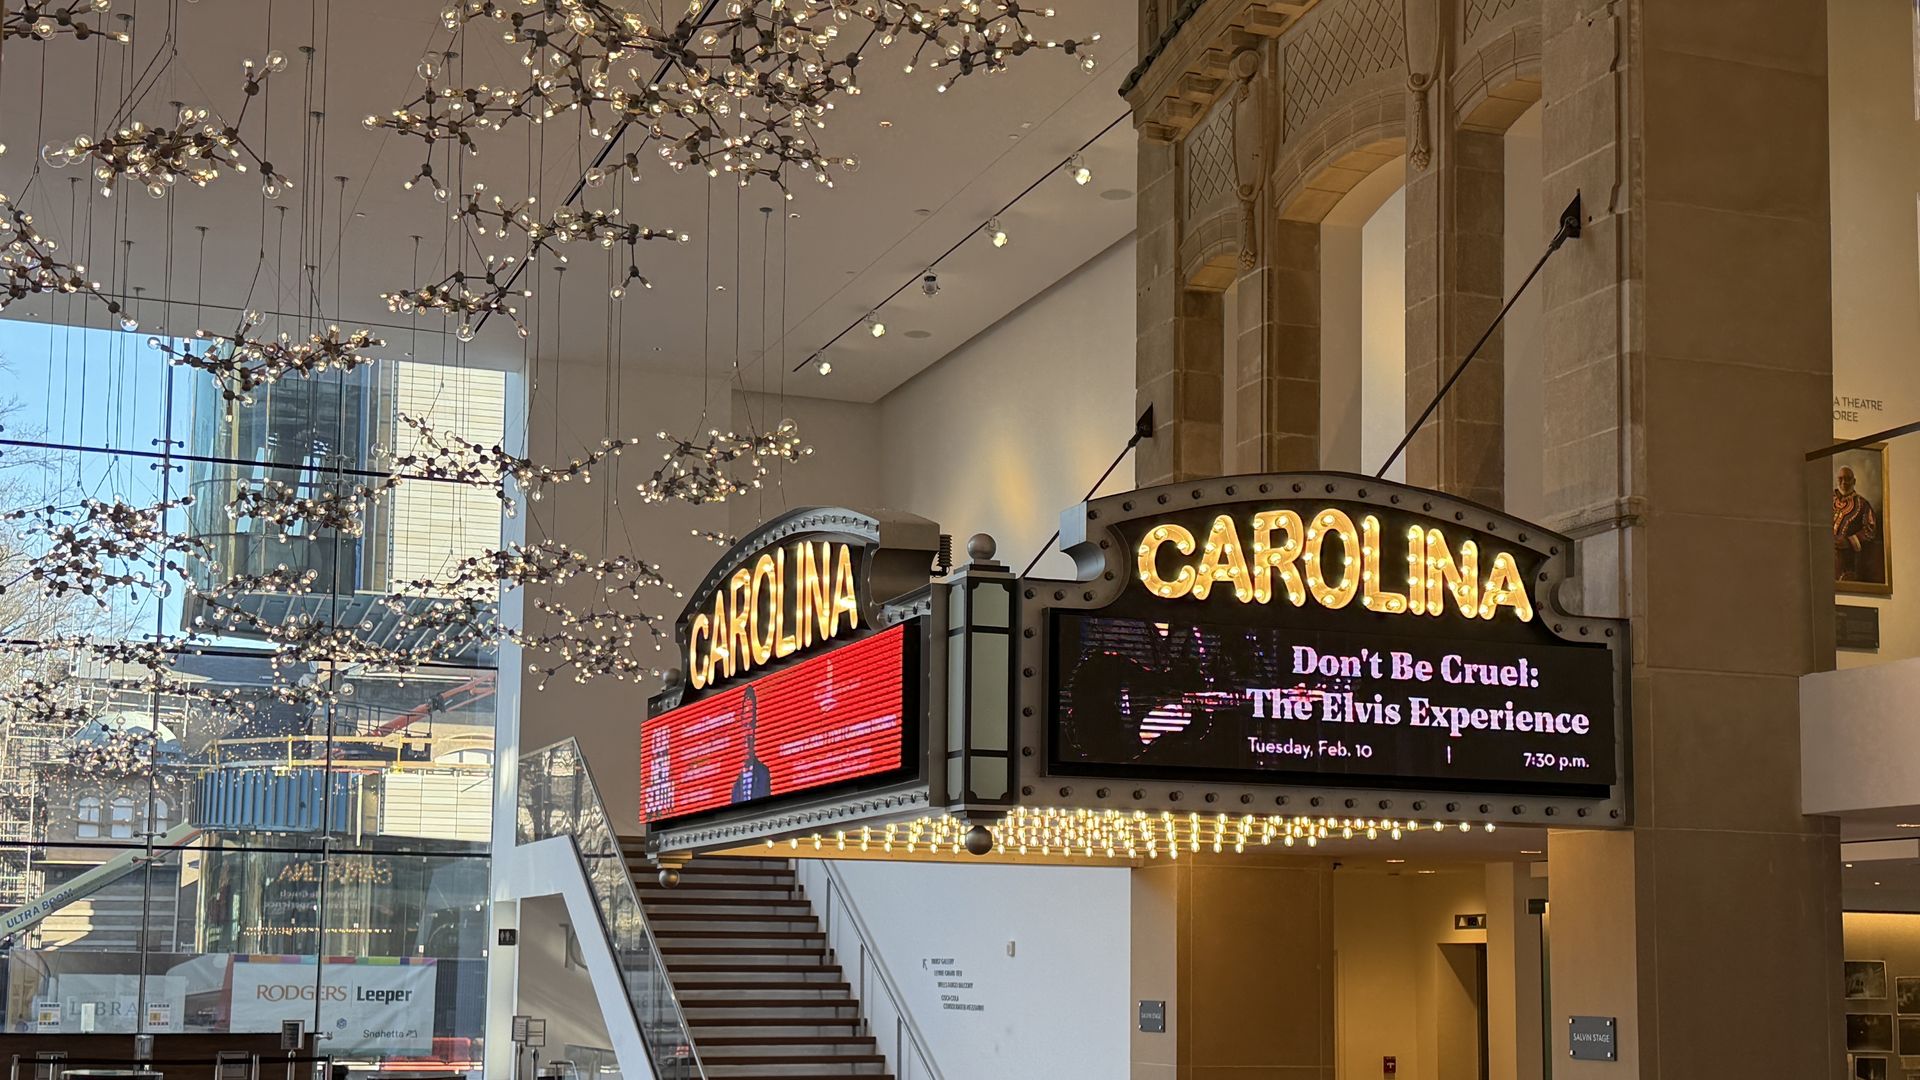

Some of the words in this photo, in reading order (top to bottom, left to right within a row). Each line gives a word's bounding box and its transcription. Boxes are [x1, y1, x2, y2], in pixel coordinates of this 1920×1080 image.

[1841, 396, 1884, 411] THEATRE
[1138, 507, 1534, 623] CAROLINA
[690, 540, 858, 690] CAROLINA
[1292, 645, 1384, 680] Don't
[1390, 651, 1434, 683] Be
[1440, 654, 1540, 688] Cruel:
[1246, 687, 1313, 721] The
[1321, 691, 1402, 725] Elvis
[1408, 697, 1590, 737] Experience
[1248, 736, 1314, 759] Tuesday,
[1318, 740, 1352, 757] Feb.
[1355, 744, 1373, 758] 10
[1523, 752, 1556, 768] 7:30
[1559, 755, 1590, 771] p.m.
[6, 906, 41, 929] ULTRA
[256, 984, 348, 1002] RODGERS
[357, 986, 413, 1005] Leeper
[1573, 1032, 1592, 1042] SALVIN
[1592, 1033, 1611, 1043] STAGE
